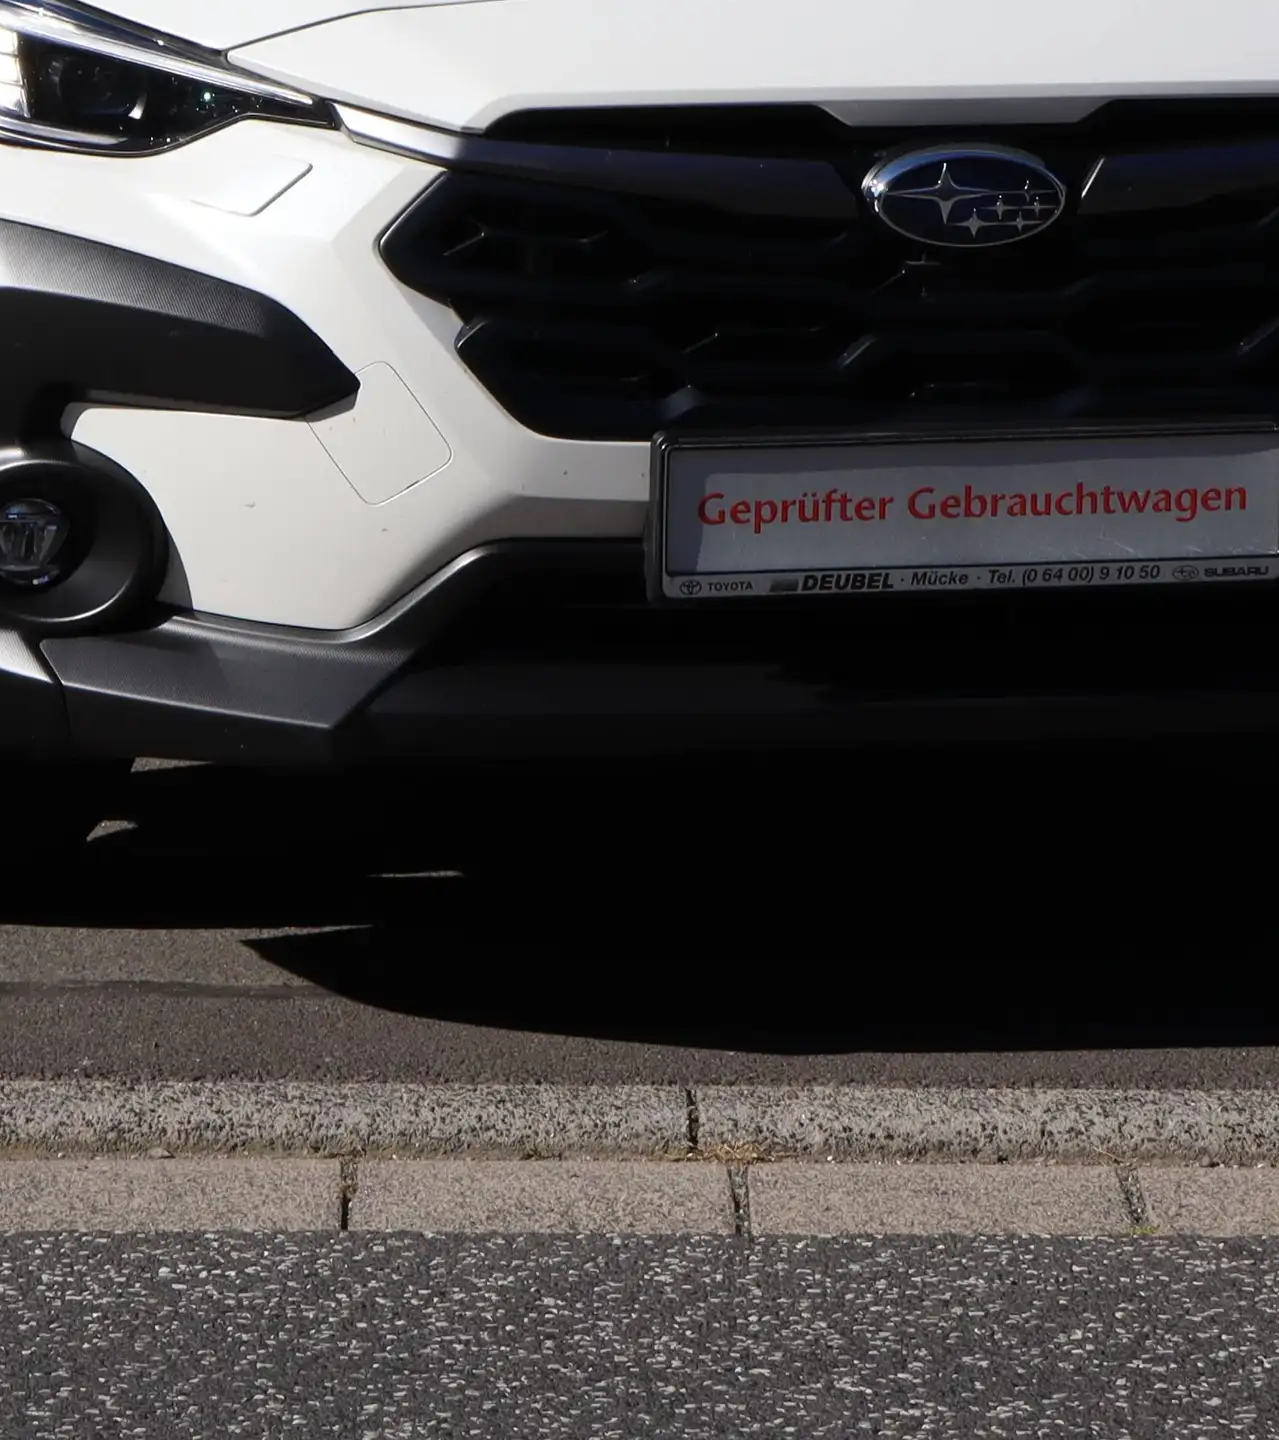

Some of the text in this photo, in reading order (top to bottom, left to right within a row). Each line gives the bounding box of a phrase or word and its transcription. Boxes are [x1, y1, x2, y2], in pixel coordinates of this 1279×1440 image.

[697, 481, 1248, 535] Geprüfter Gebrauchtwagen
[801, 572, 894, 592] DEUBEL
[910, 569, 969, 587] Mücke
[987, 569, 1016, 585] Tel.
[1041, 567, 1064, 583] 64
[1069, 565, 1095, 585] 00)
[1099, 565, 1110, 581] 9
[1115, 564, 1135, 580] 10
[1138, 564, 1161, 580] 50
[1203, 565, 1270, 578] SUBARU
[707, 581, 753, 593] TOYOTA
